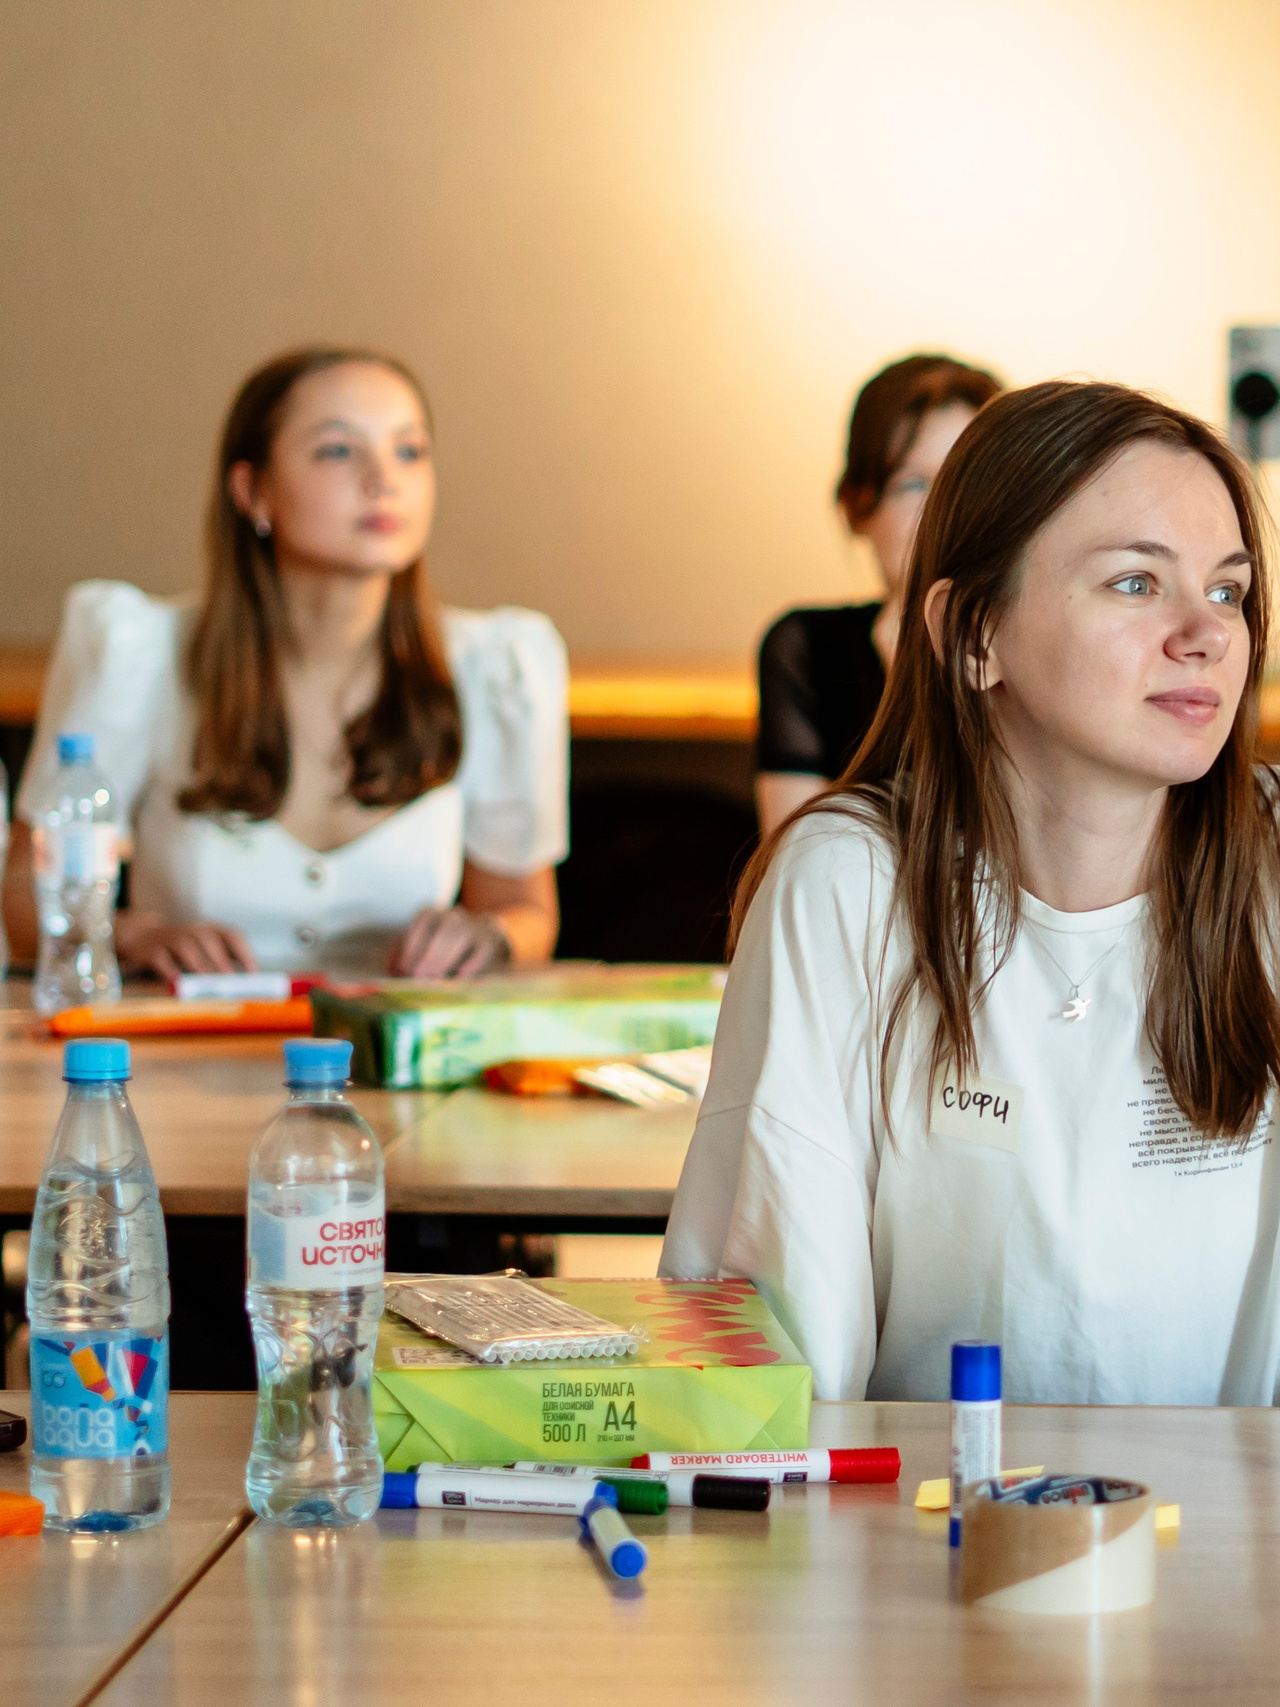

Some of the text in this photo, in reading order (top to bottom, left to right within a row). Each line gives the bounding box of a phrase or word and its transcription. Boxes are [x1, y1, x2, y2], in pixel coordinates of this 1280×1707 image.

[1143, 1108, 1155, 1116] не
[1143, 1116, 1180, 1126] своего,
[1154, 1126, 1192, 1135] мыслит
[1129, 1137, 1180, 1148] неправде,
[1138, 1148, 1155, 1157] всё
[1157, 1143, 1214, 1156] покрывает,
[1132, 1159, 1160, 1168] всего
[1162, 1154, 1211, 1166] надеется,
[1213, 1149, 1229, 1159] всё
[320, 1216, 384, 1242] СВЯТО
[301, 1241, 384, 1266] ИСТОЧН
[542, 1382, 635, 1398] БЕЛАЯ БУМАГА
[542, 1412, 575, 1422] ТЕХНИКИ
[542, 1423, 586, 1442] 500 Л
[671, 1453, 808, 1466] WHITEBOARD MARKER
